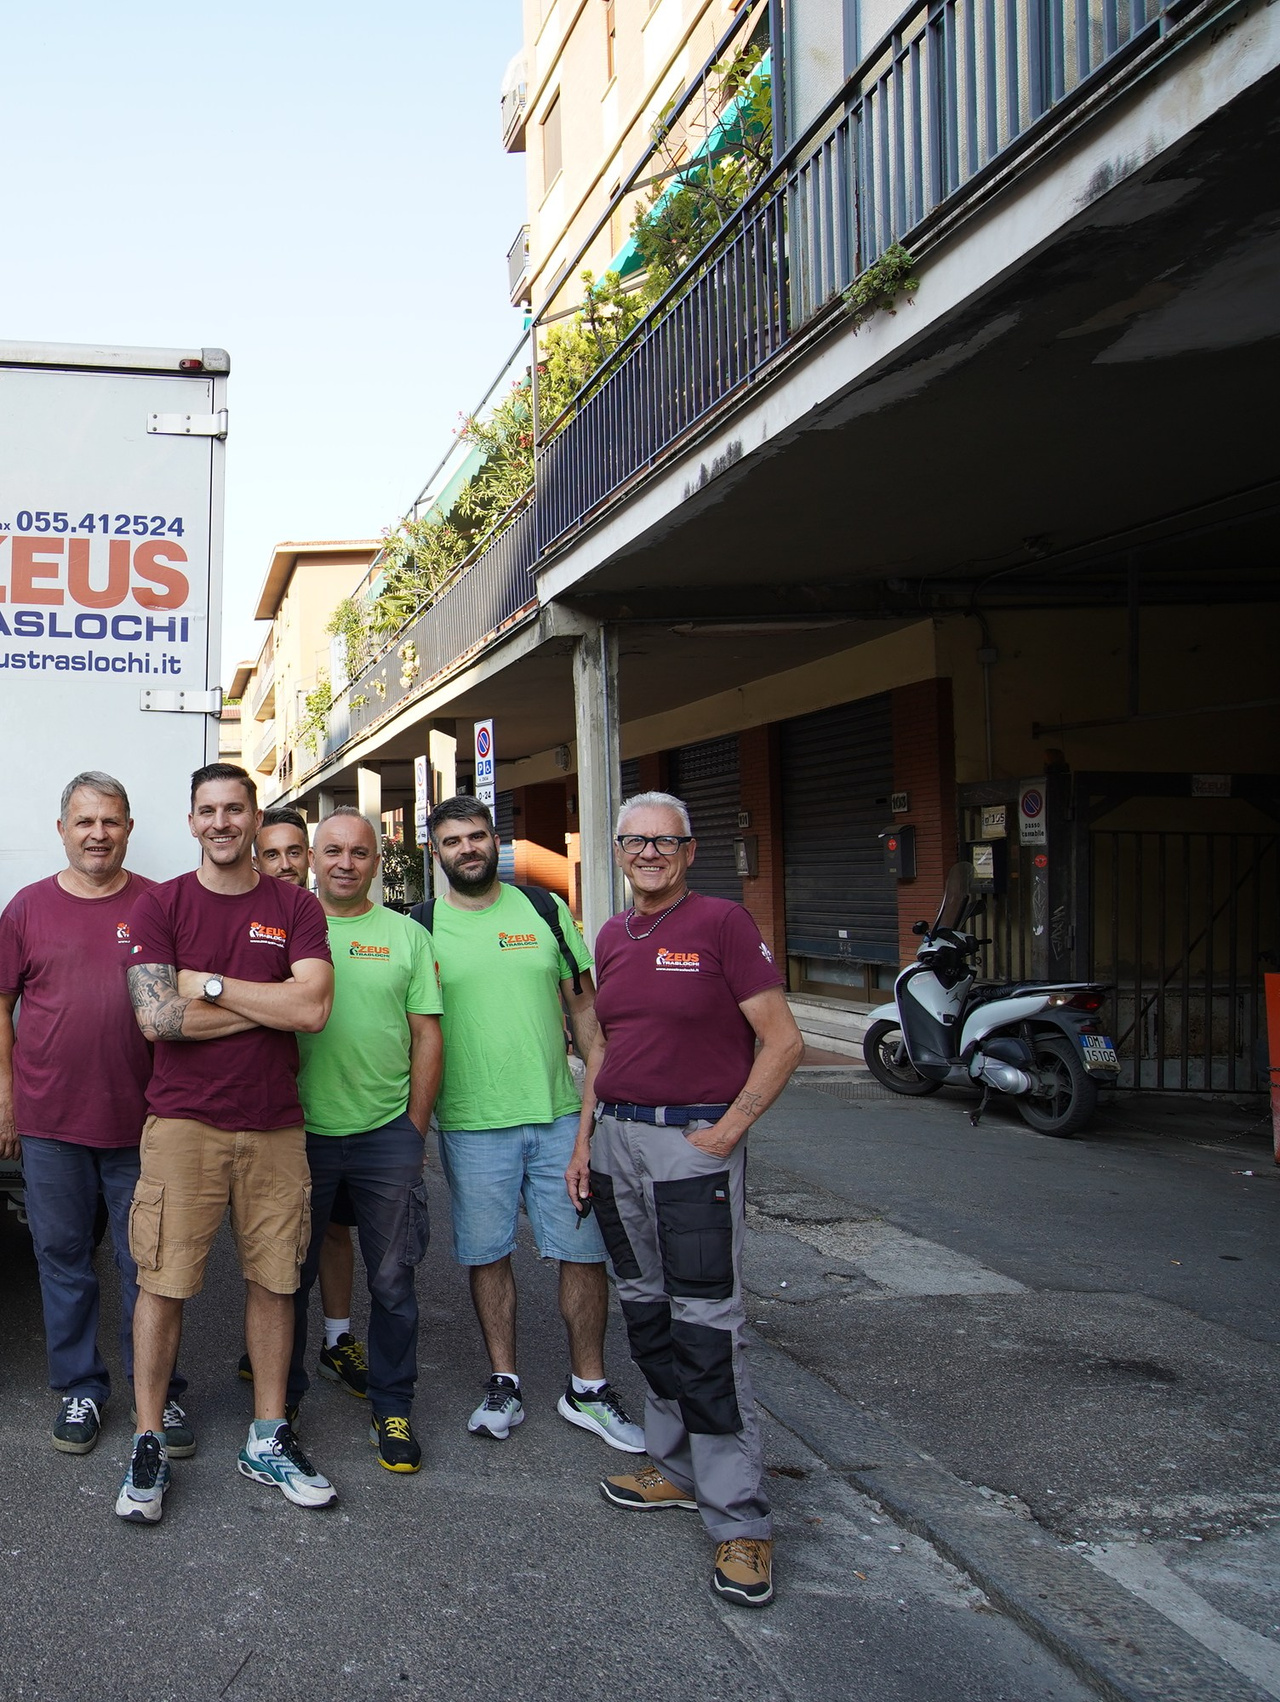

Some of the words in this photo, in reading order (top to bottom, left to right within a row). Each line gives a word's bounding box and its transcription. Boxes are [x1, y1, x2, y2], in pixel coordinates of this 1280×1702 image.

[16, 510, 185, 537] 055.412524
[258, 926, 287, 938] ZEUS
[507, 934, 536, 944] ZEUS
[358, 946, 390, 954] ZEUS
[665, 952, 700, 962] ZEUS
[1088, 1036, 1100, 1047] DM
[1087, 1050, 1116, 1062] 15105
